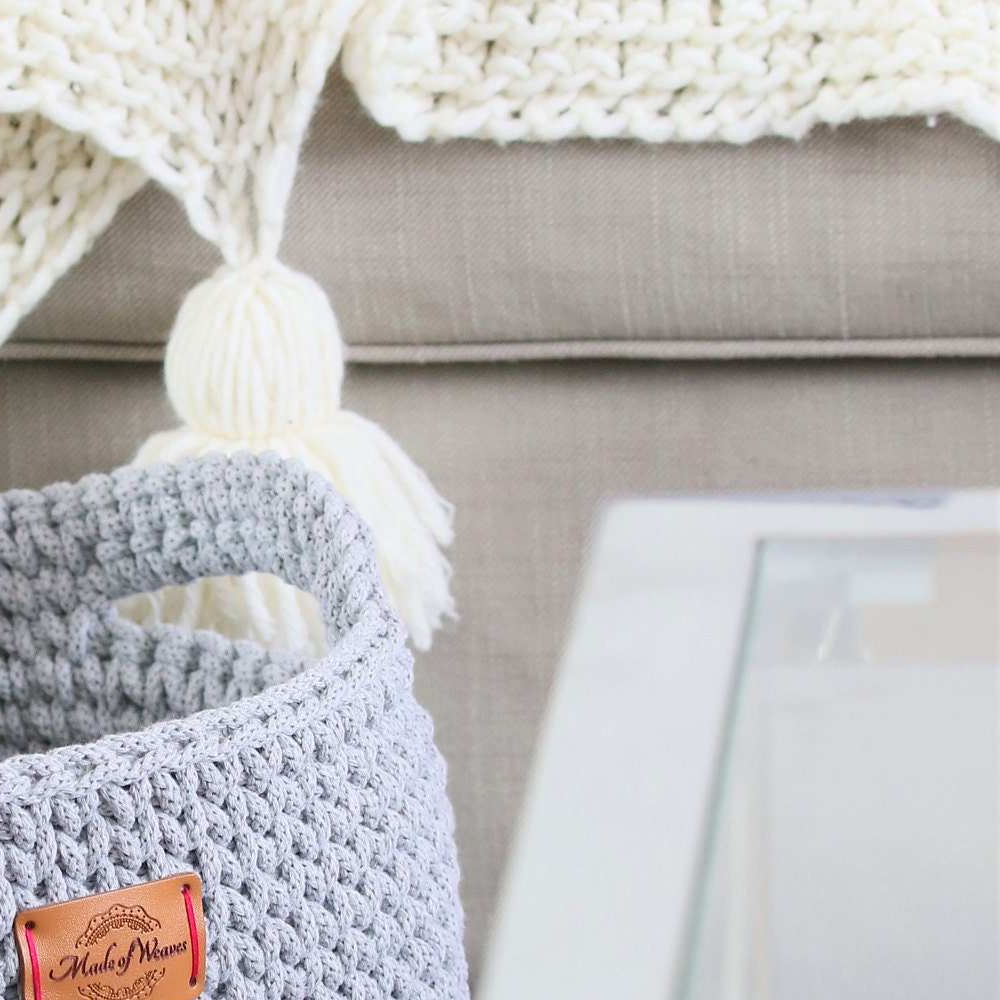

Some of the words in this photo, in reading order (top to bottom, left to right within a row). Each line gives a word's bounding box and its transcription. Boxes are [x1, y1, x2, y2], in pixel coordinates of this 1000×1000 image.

[49, 942, 117, 982] Made
[116, 938, 140, 976] of
[136, 937, 187, 963] Weaves
